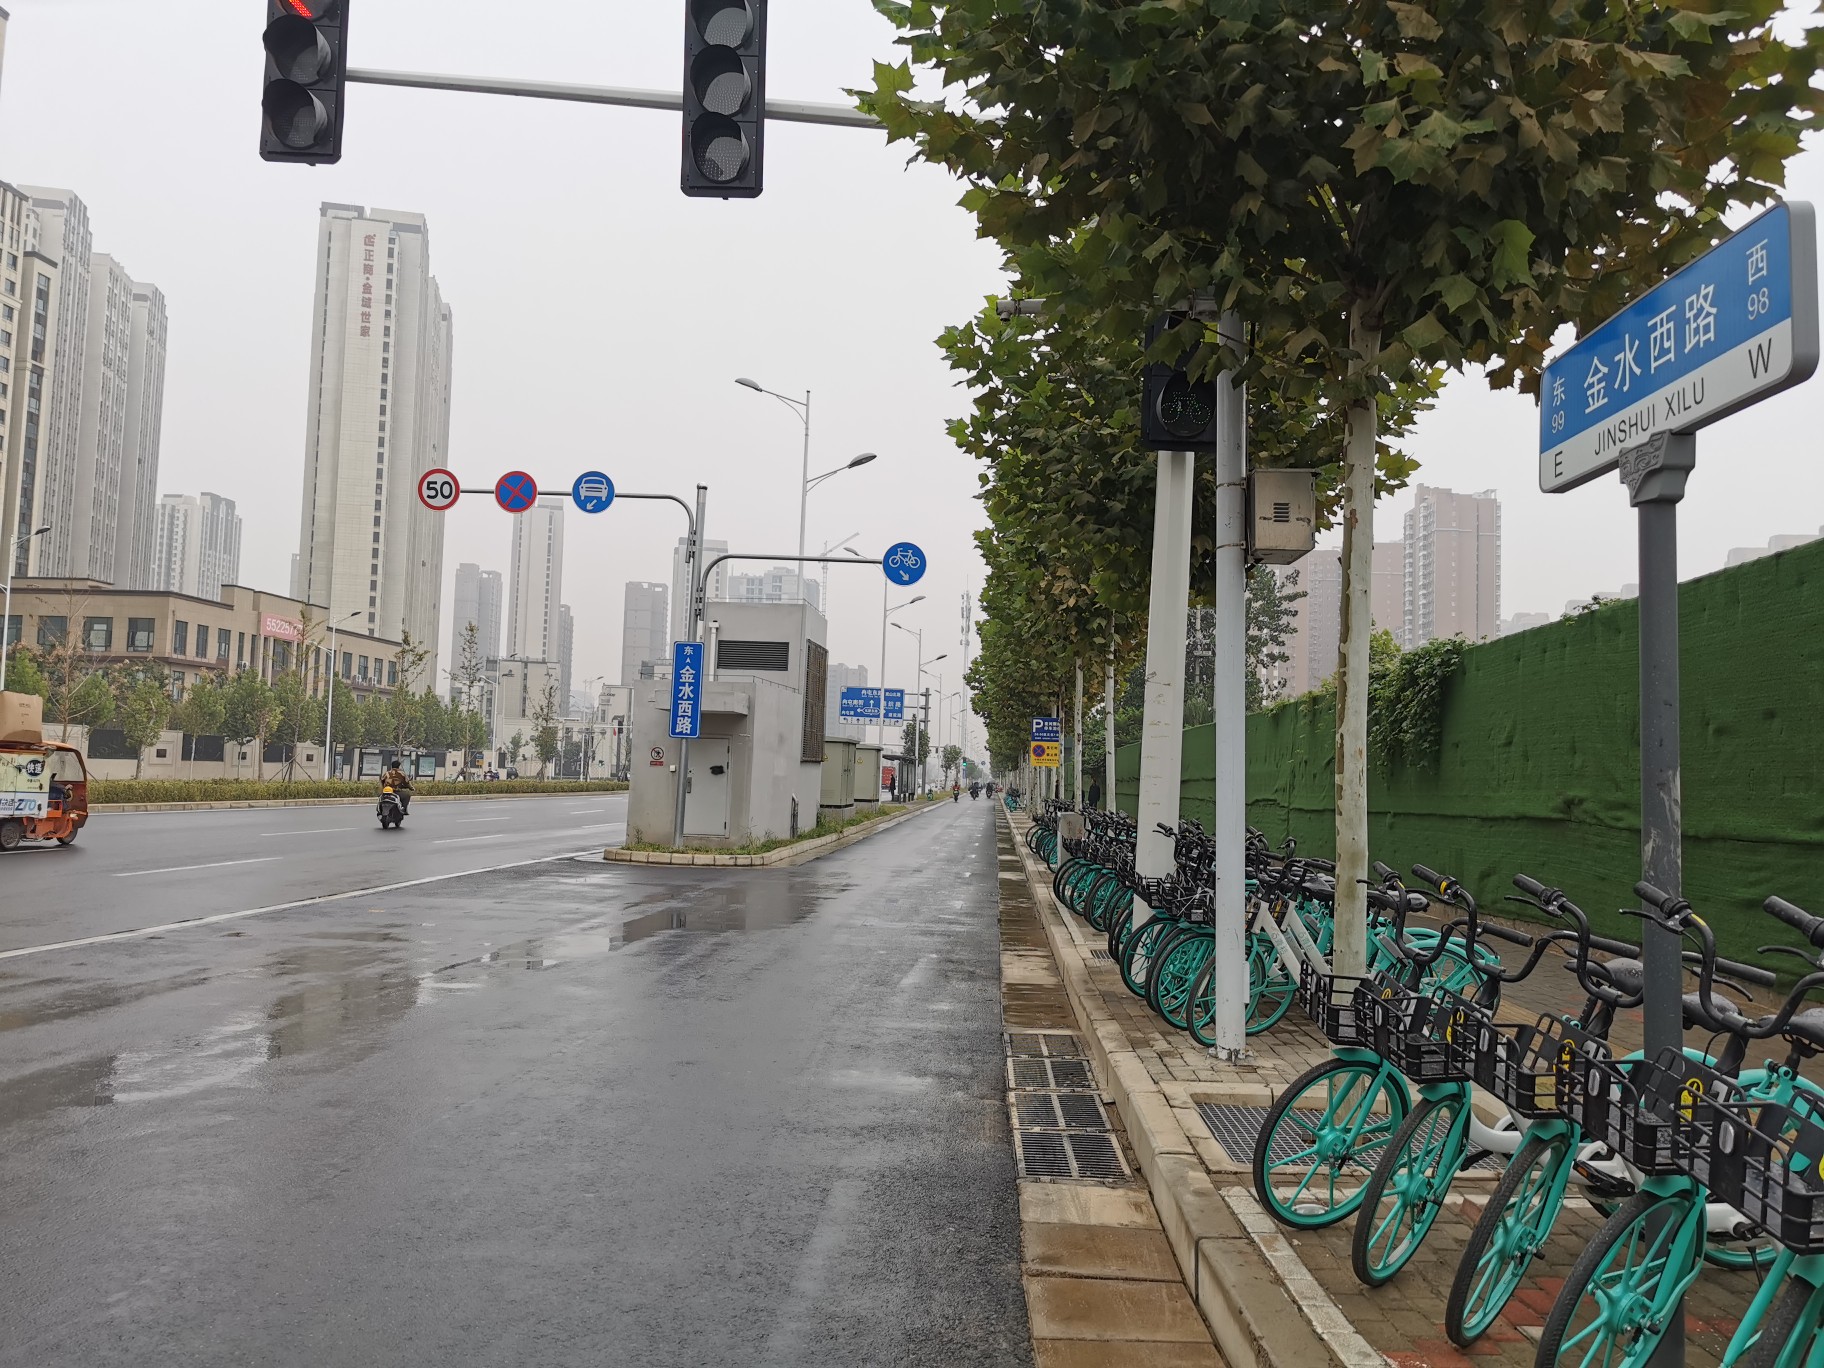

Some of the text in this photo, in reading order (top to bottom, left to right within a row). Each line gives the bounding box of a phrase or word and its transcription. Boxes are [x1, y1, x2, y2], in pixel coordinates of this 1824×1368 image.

[1746, 239, 1768, 285] 西
[1748, 287, 1770, 321] 98
[1583, 284, 1718, 414] 金水西路
[1748, 338, 1772, 379] W
[1552, 376, 1566, 407] 东
[1551, 411, 1565, 434] 99
[1594, 377, 1705, 456] JINSHUI XILU
[1554, 451, 1563, 478] E
[426, 481, 453, 499] 50
[683, 646, 694, 655] 东
[675, 665, 696, 734] 金水西路
[1032, 719, 1044, 733] P
[15, 798, 37, 811] ZTO
